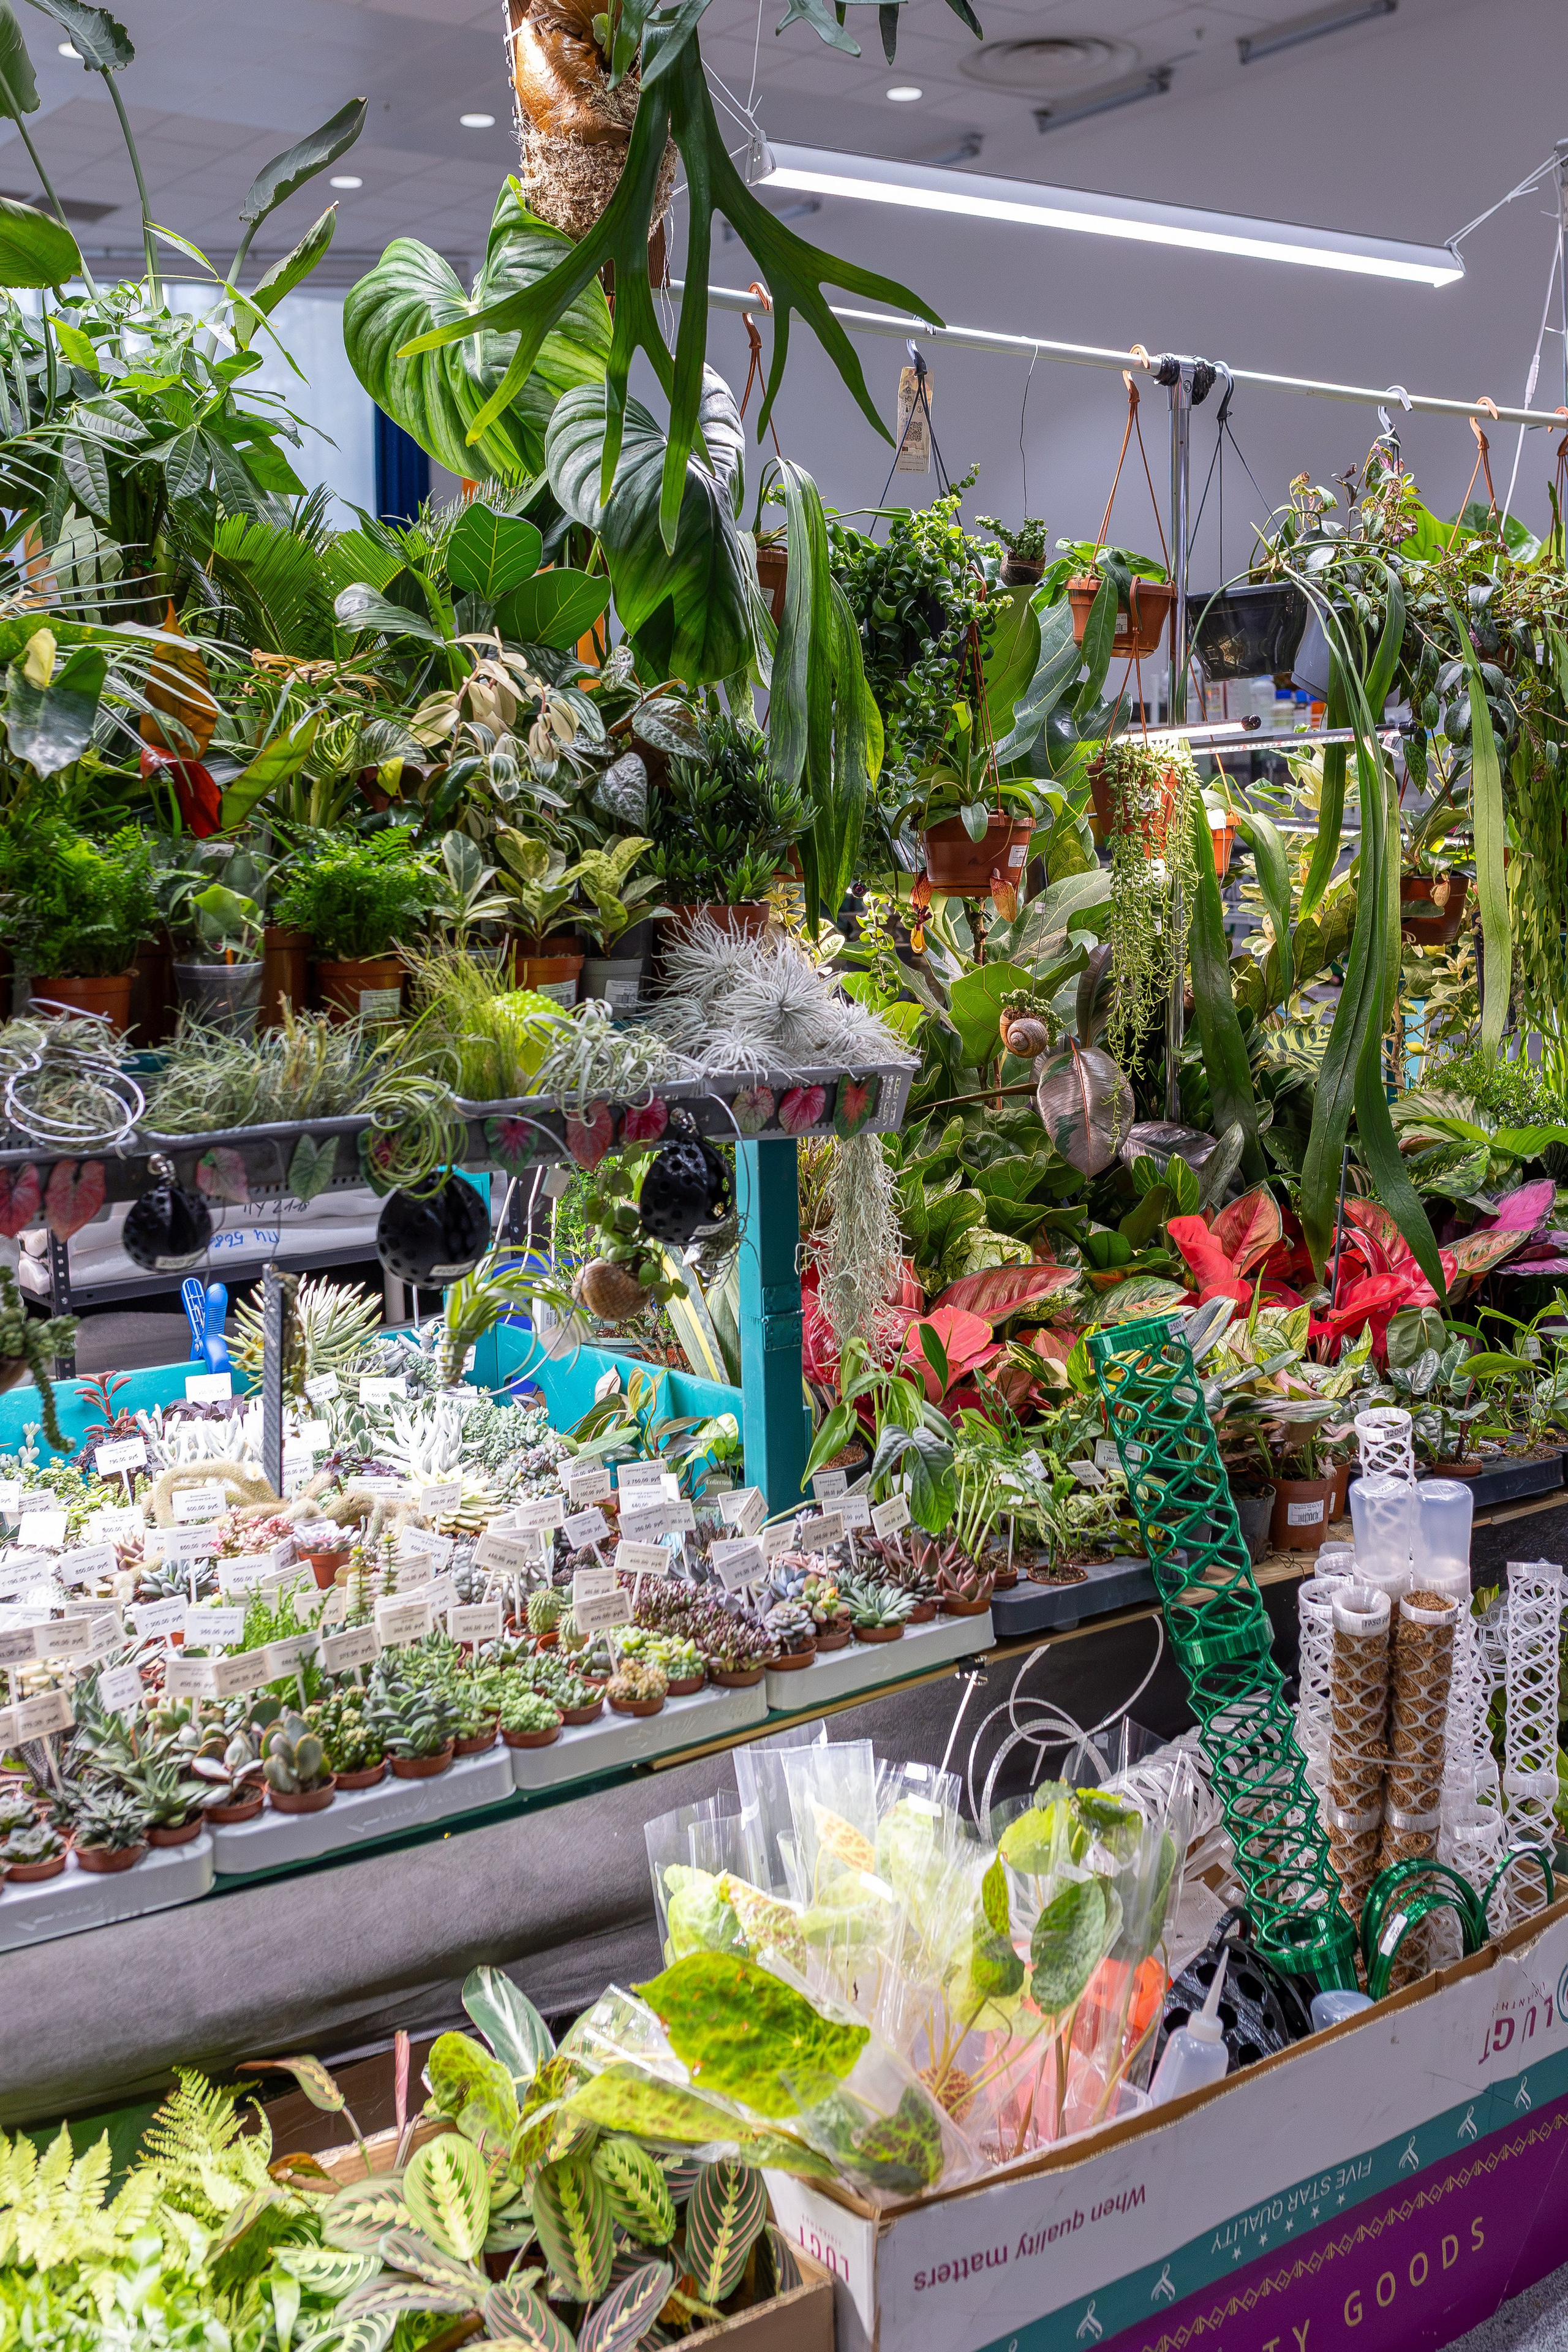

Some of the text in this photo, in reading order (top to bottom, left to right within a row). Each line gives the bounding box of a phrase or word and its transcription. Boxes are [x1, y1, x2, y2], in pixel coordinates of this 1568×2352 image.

[1385, 1427, 1404, 1438] 1200
[1478, 1994, 1554, 2065] LUGT
[913, 2183, 1146, 2292] When quality matters
[1211, 2155, 1372, 2255] FIVE STAR QUALITY
[1343, 2215, 1485, 2328] GOODS
